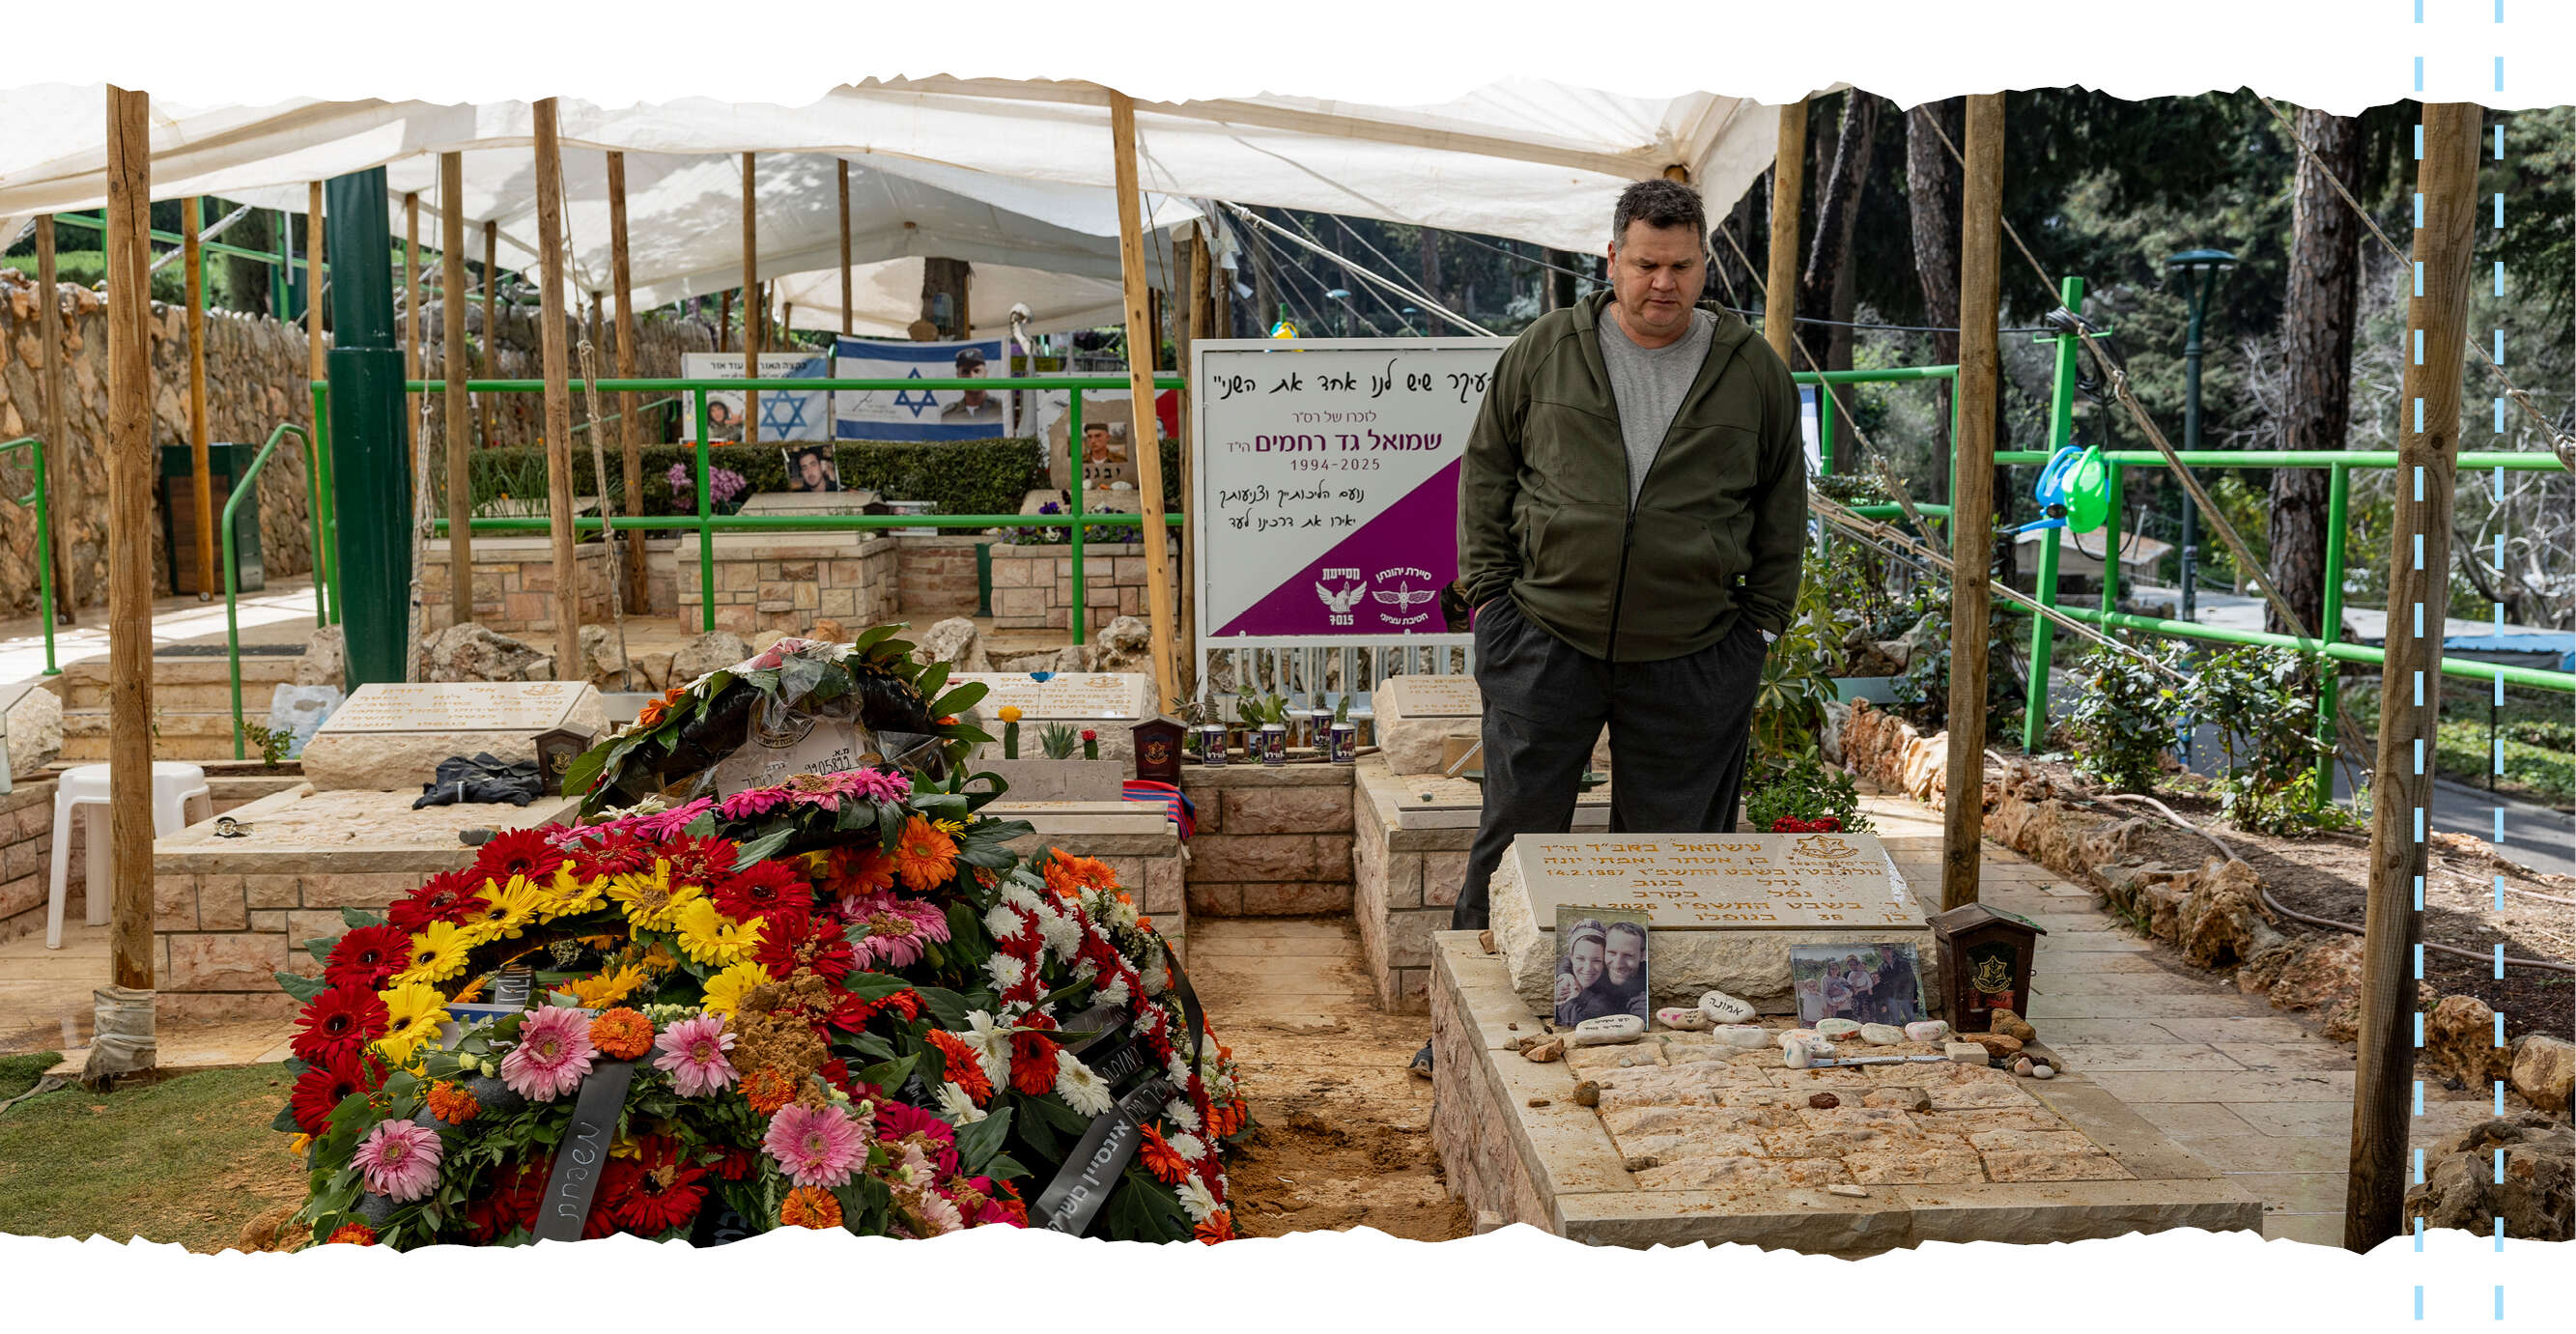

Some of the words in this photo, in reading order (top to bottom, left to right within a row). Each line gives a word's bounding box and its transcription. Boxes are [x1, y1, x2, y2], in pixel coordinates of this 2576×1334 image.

[711, 361, 726, 370] אור
[1269, 372, 1303, 394] את
[1316, 371, 1357, 391] אחד
[1372, 357, 1398, 398] לנו
[1406, 373, 1432, 391] שיש
[1291, 412, 1321, 424] רס"ר
[1324, 410, 1343, 423] של
[1345, 410, 1377, 424] לזכרו
[1227, 440, 1251, 453] הי"ד
[1255, 433, 1326, 452] רחמים
[1334, 434, 1361, 452] גד
[1367, 428, 1443, 452] שמואל
[1290, 458, 1381, 471] 1994-2025
[1219, 484, 1270, 509] וצניעותך
[1338, 486, 1365, 503] נועם
[1229, 507, 1253, 529] לעד
[1258, 516, 1294, 532] דרכינו
[1300, 515, 1322, 528] את
[1330, 514, 1356, 527] יאירו
[1375, 566, 1403, 583] יהונתן
[1404, 566, 1432, 582] סיירת
[1328, 614, 1354, 626] 7015
[1539, 843, 1579, 853] הי"ד
[1585, 842, 1660, 853] באב"ד
[1670, 841, 1762, 853] עשהאל
[1746, 856, 1770, 866] בן
[1724, 867, 1787, 877] בשבט
[1756, 878, 1801, 887] גדל
[1631, 890, 1701, 899] בקרב
[1767, 889, 1813, 898] נפל
[1785, 900, 1865, 910] בשבט
[1694, 912, 1777, 922] בנופלו
[1817, 913, 1845, 922] 38
[1882, 912, 1911, 923] בן
[1708, 997, 1744, 1016] אמונה
